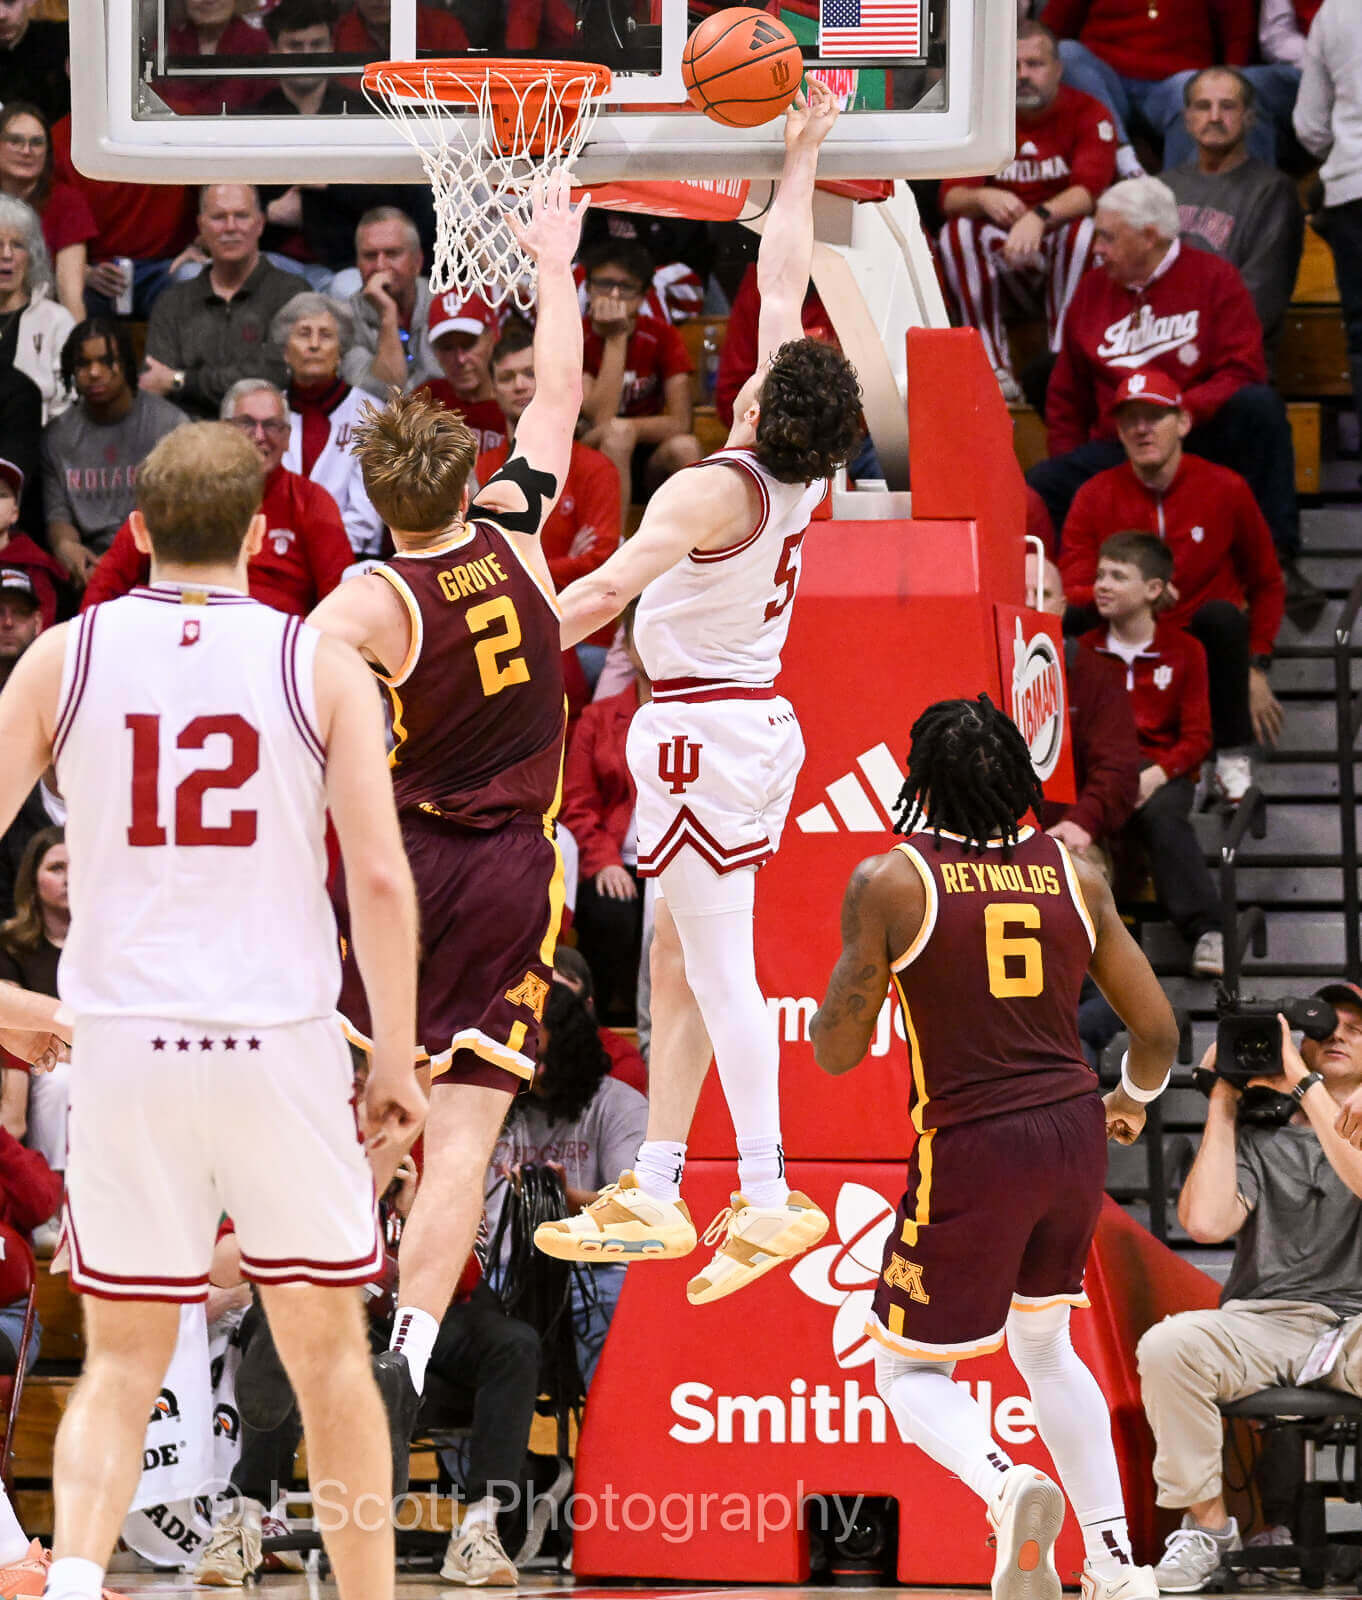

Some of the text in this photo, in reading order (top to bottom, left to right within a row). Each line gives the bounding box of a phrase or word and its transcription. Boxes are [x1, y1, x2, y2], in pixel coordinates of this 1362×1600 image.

[1097, 304, 1199, 358] Indiana
[437, 552, 509, 602] GROVE
[763, 533, 804, 623] 5
[464, 595, 532, 697] 2
[125, 713, 260, 847] 12
[939, 862, 1061, 896] REYNOLDS
[983, 902, 1044, 999] 6
[668, 1378, 1037, 1445] Smithle
